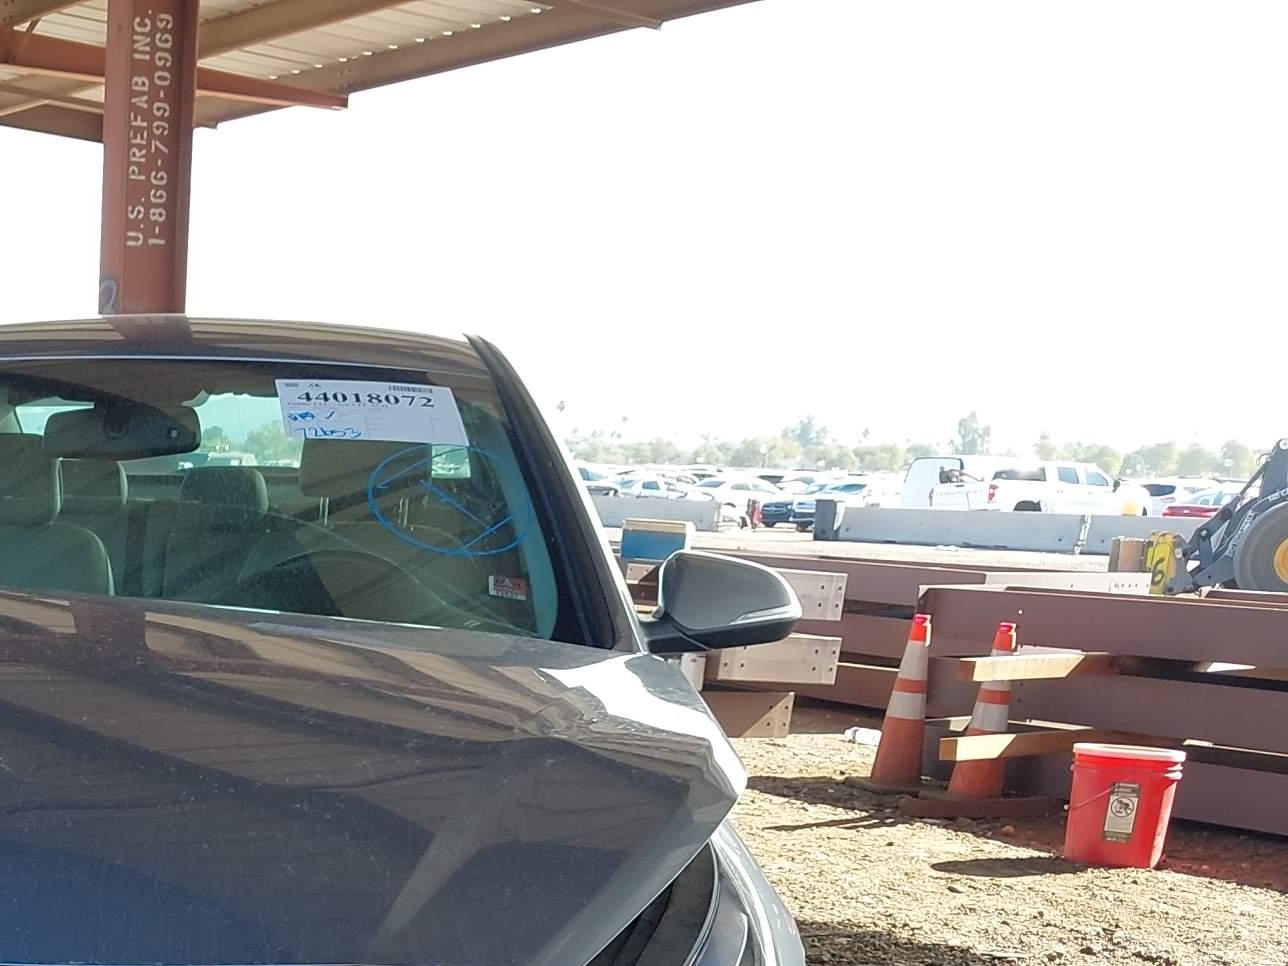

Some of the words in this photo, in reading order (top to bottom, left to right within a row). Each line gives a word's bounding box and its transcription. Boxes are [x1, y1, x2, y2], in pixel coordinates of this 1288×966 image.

[133, 8, 152, 60] INC.
[128, 75, 149, 181] PREFAB
[148, 13, 173, 245] 1-866-799-0969
[125, 196, 145, 246] U.S.
[296, 391, 435, 409] 44018072
